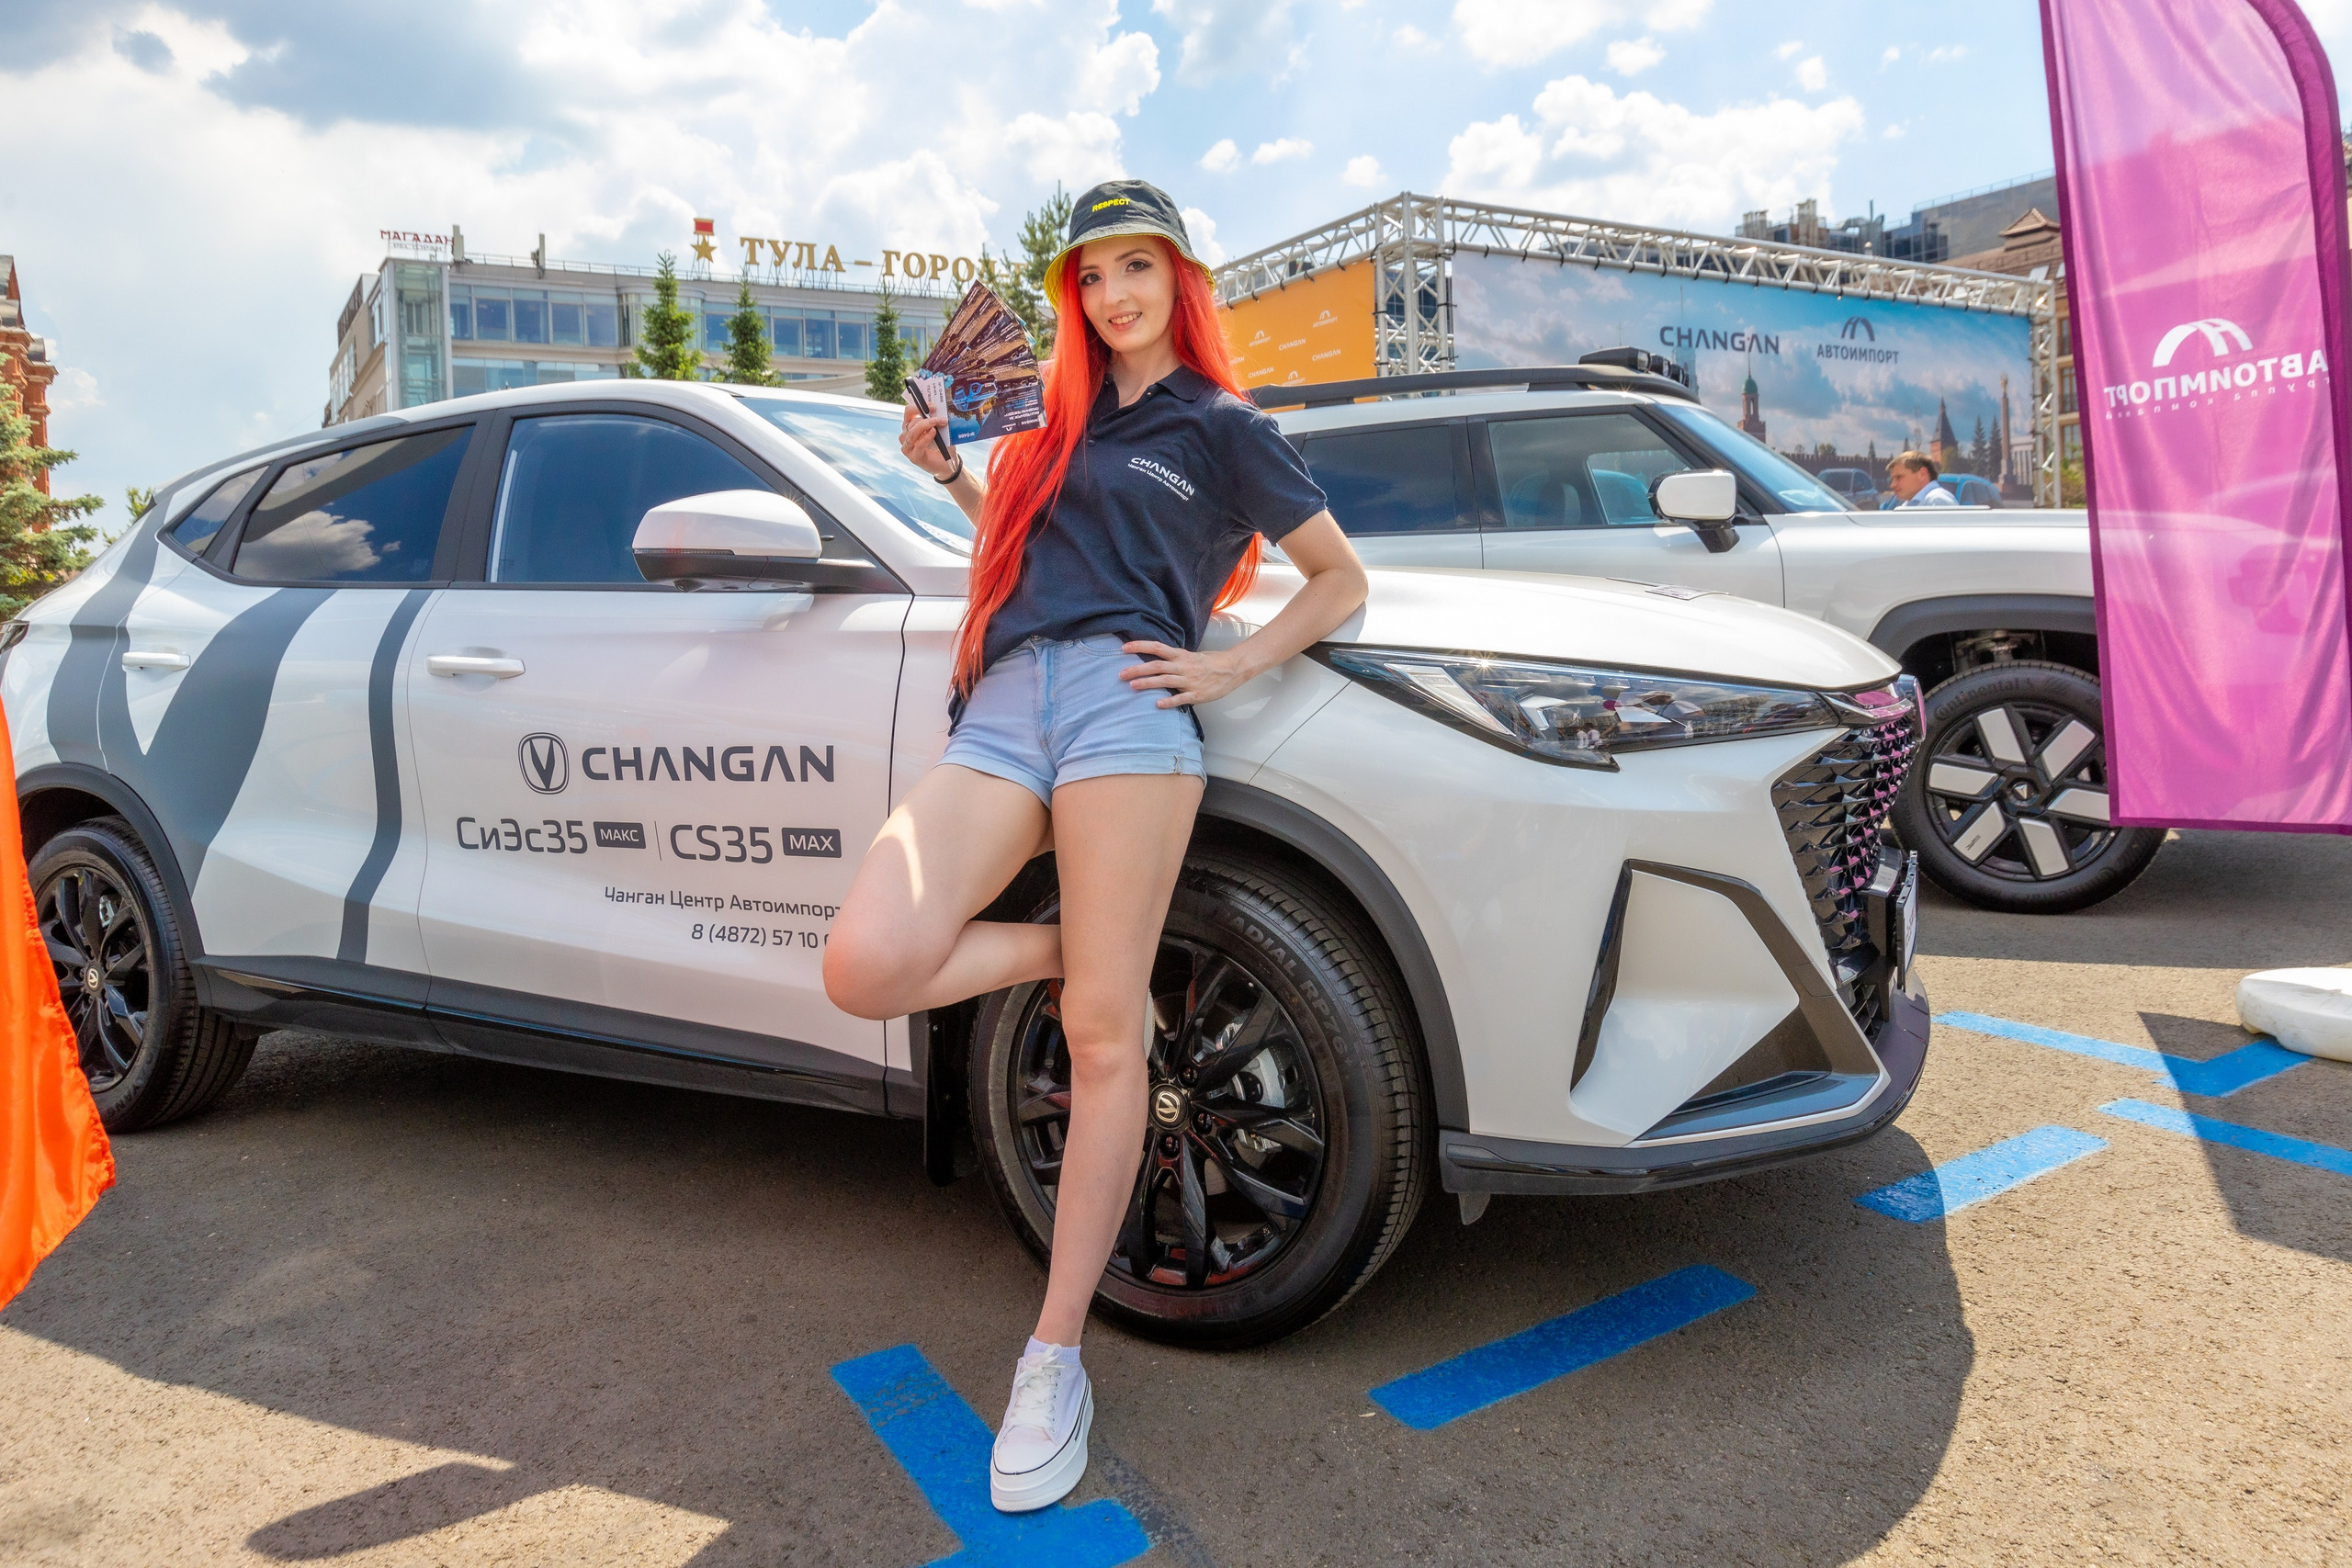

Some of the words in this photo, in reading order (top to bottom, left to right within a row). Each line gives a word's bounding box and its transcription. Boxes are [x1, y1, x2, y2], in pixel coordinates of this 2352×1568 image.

[1091, 198, 1130, 212] RESPECT
[379, 230, 454, 246] МАГАДАН
[740, 236, 846, 273] ТУЛА
[1278, 338, 1306, 351] CHANGAN
[1659, 325, 1780, 355] CHANGAN
[1312, 348, 1341, 362] CHANGAN
[1816, 344, 1900, 365] АВТОИМПОРТ
[1248, 367, 1274, 378] CHANGAN
[1131, 457, 1194, 496] CHANGAN
[1147, 469, 1163, 482] Центр
[1162, 479, 1189, 502] Автоимпорт
[582, 745, 835, 783] CHANGAN
[456, 816, 589, 855] СиЭс35
[600, 828, 640, 842] МАКС
[670, 823, 774, 864] CS35
[789, 835, 835, 852] MAX
[605, 886, 665, 906] Чанган
[670, 891, 725, 912] Центр
[691, 923, 704, 940] 8
[708, 924, 767, 948] (4872)
[772, 929, 793, 946] 57
[797, 931, 819, 949] 10
